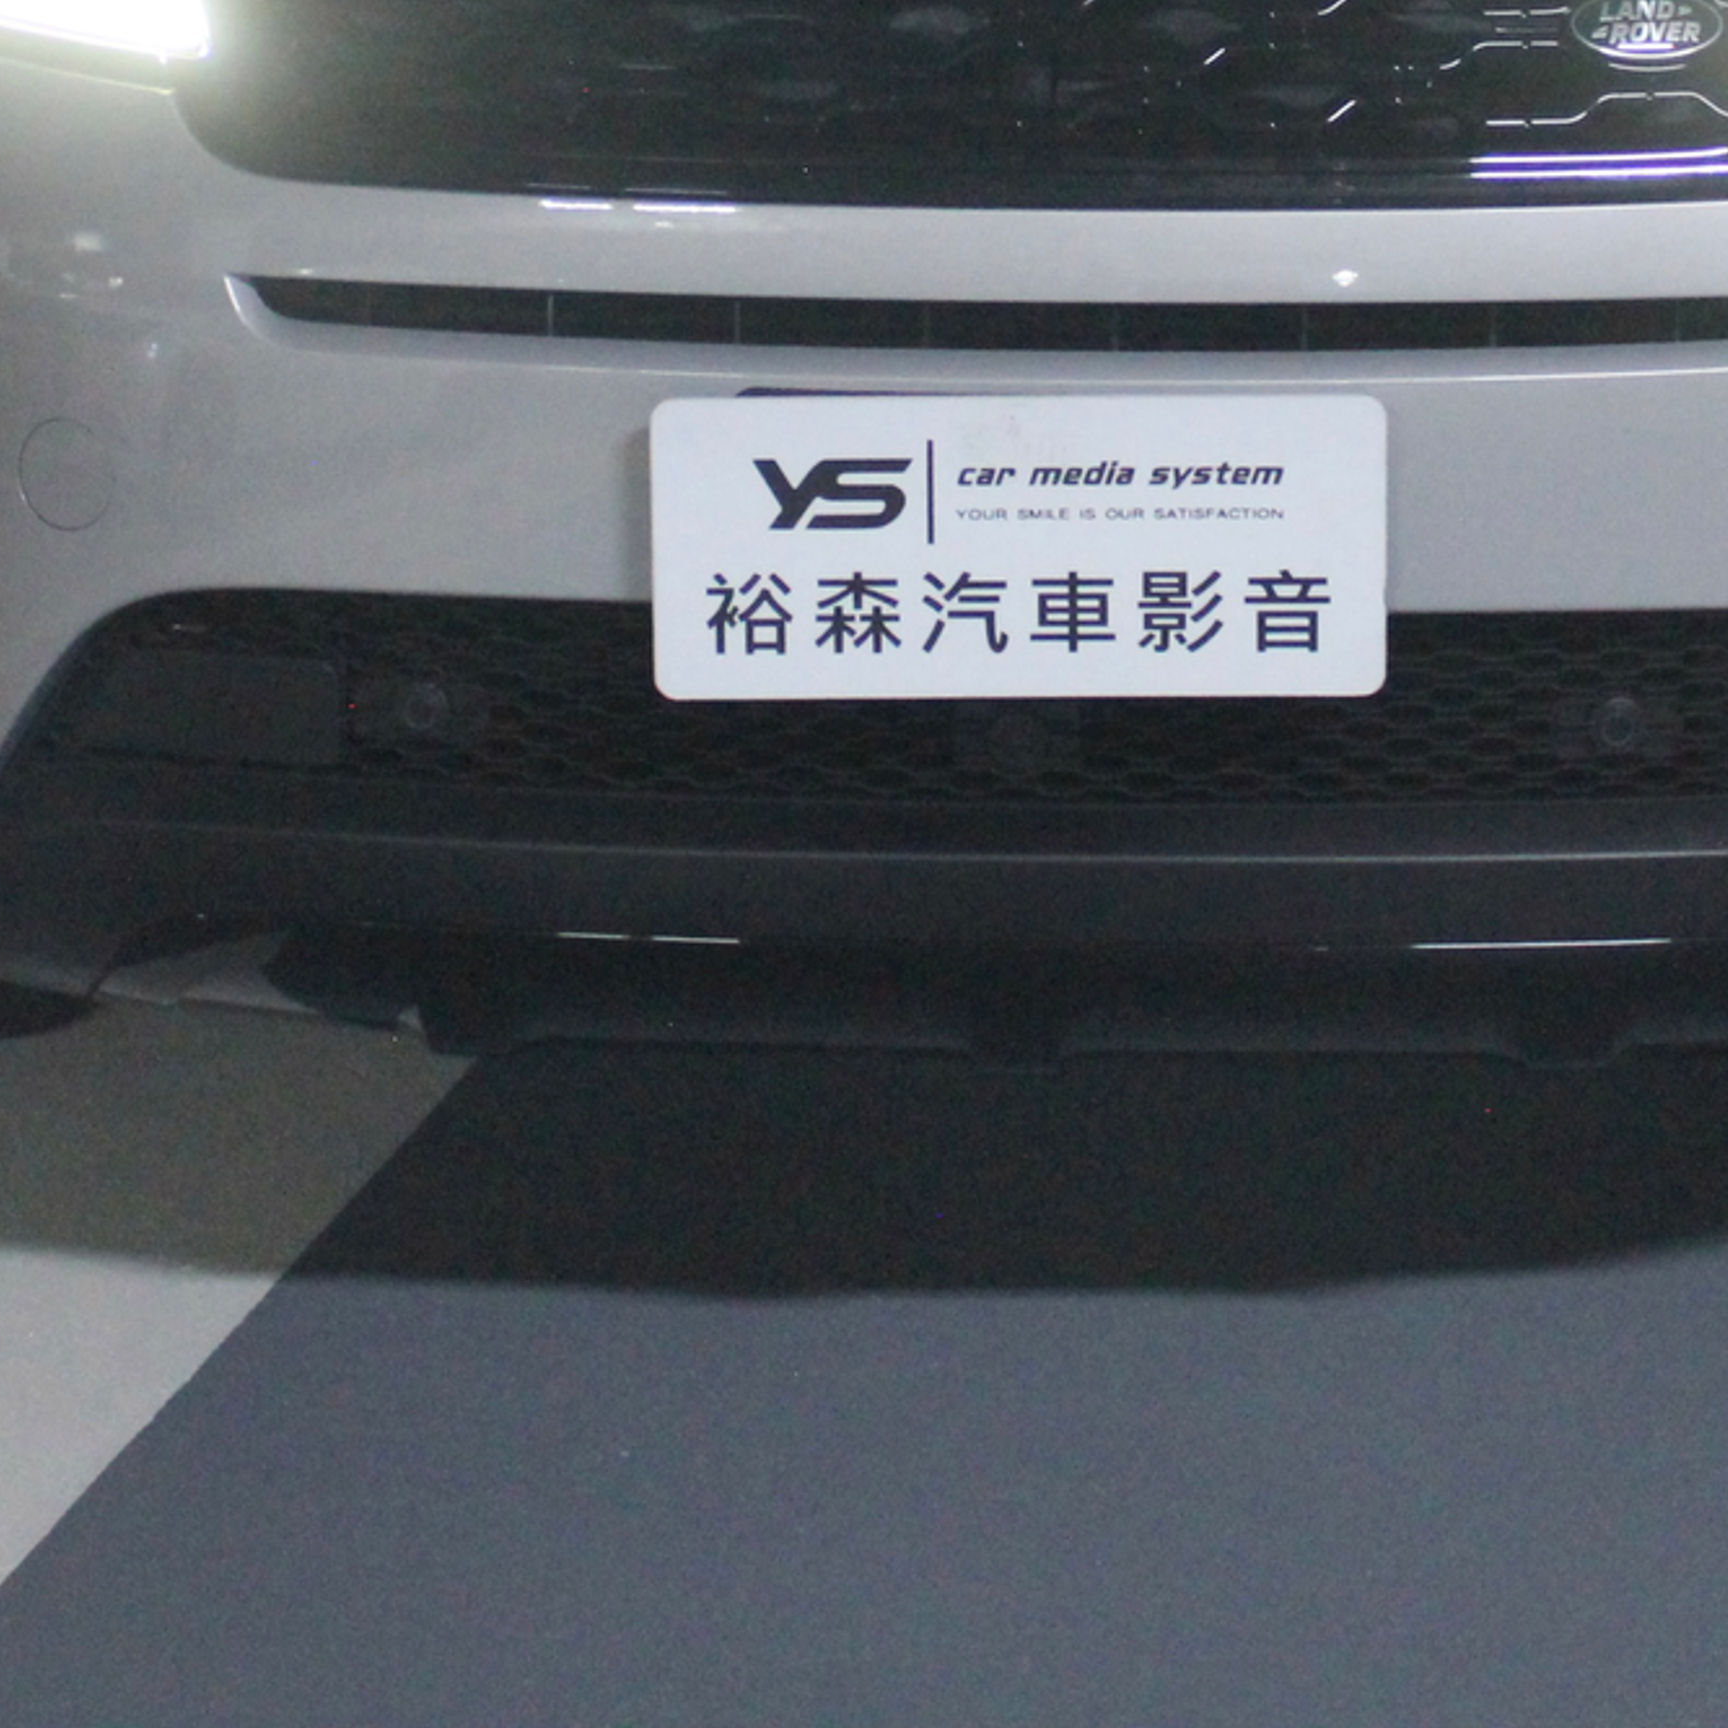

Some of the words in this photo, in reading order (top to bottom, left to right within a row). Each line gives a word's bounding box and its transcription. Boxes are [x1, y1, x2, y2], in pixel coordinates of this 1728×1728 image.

[1609, 21, 1701, 46] ROVER
[957, 467, 1017, 486] car
[1028, 460, 1136, 486] media
[1149, 462, 1284, 490] system
[752, 459, 913, 530] YS
[956, 508, 1008, 520] YOUR
[1017, 508, 1070, 520] SMILE
[1079, 508, 1096, 520] IS
[1105, 508, 1145, 520] OUR
[1153, 508, 1285, 520] SATISFACTION
[706, 571, 1332, 655] 裕森汽車影音
